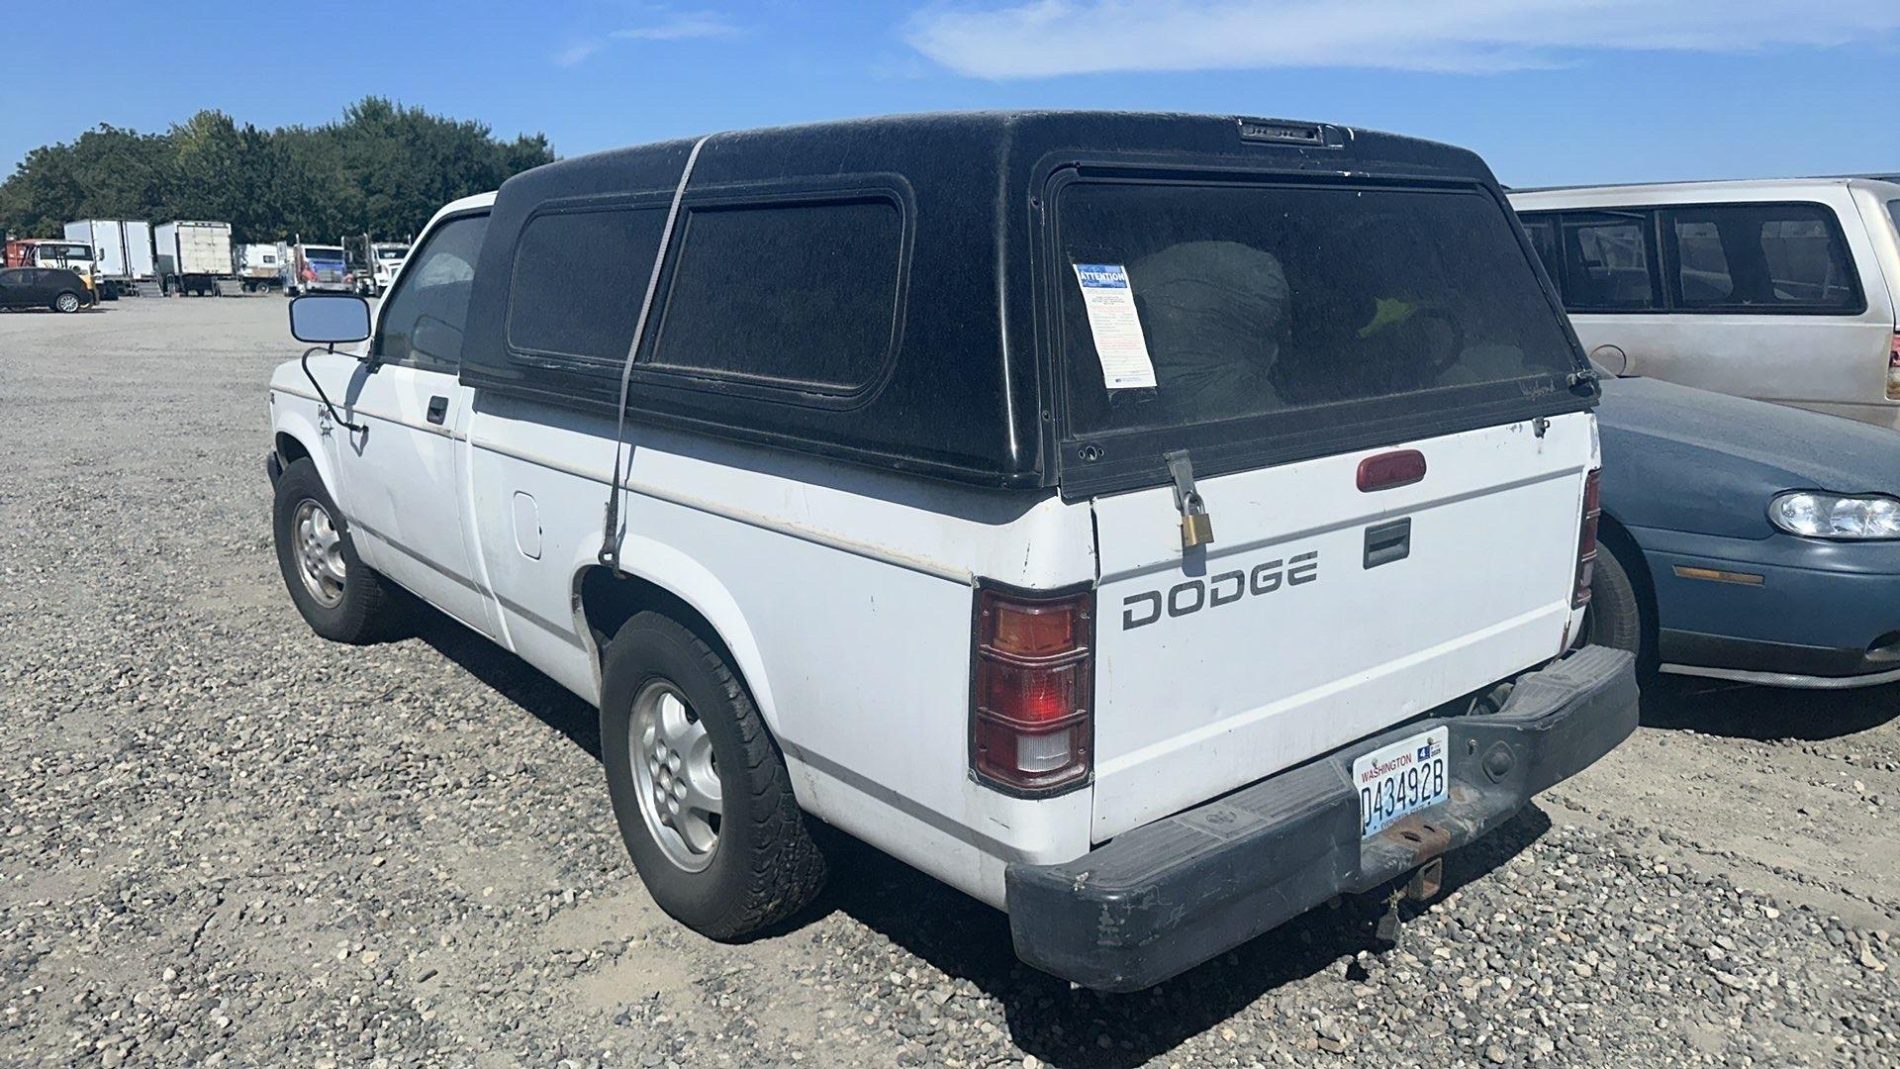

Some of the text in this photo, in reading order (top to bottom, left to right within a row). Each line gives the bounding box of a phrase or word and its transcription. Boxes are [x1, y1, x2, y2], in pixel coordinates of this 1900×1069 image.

[1080, 272, 1125, 281] ATTENTION
[1123, 550, 1318, 631] DODGE
[1361, 753, 1412, 783] WASHINGTON
[1361, 758, 1443, 827] D43492B
